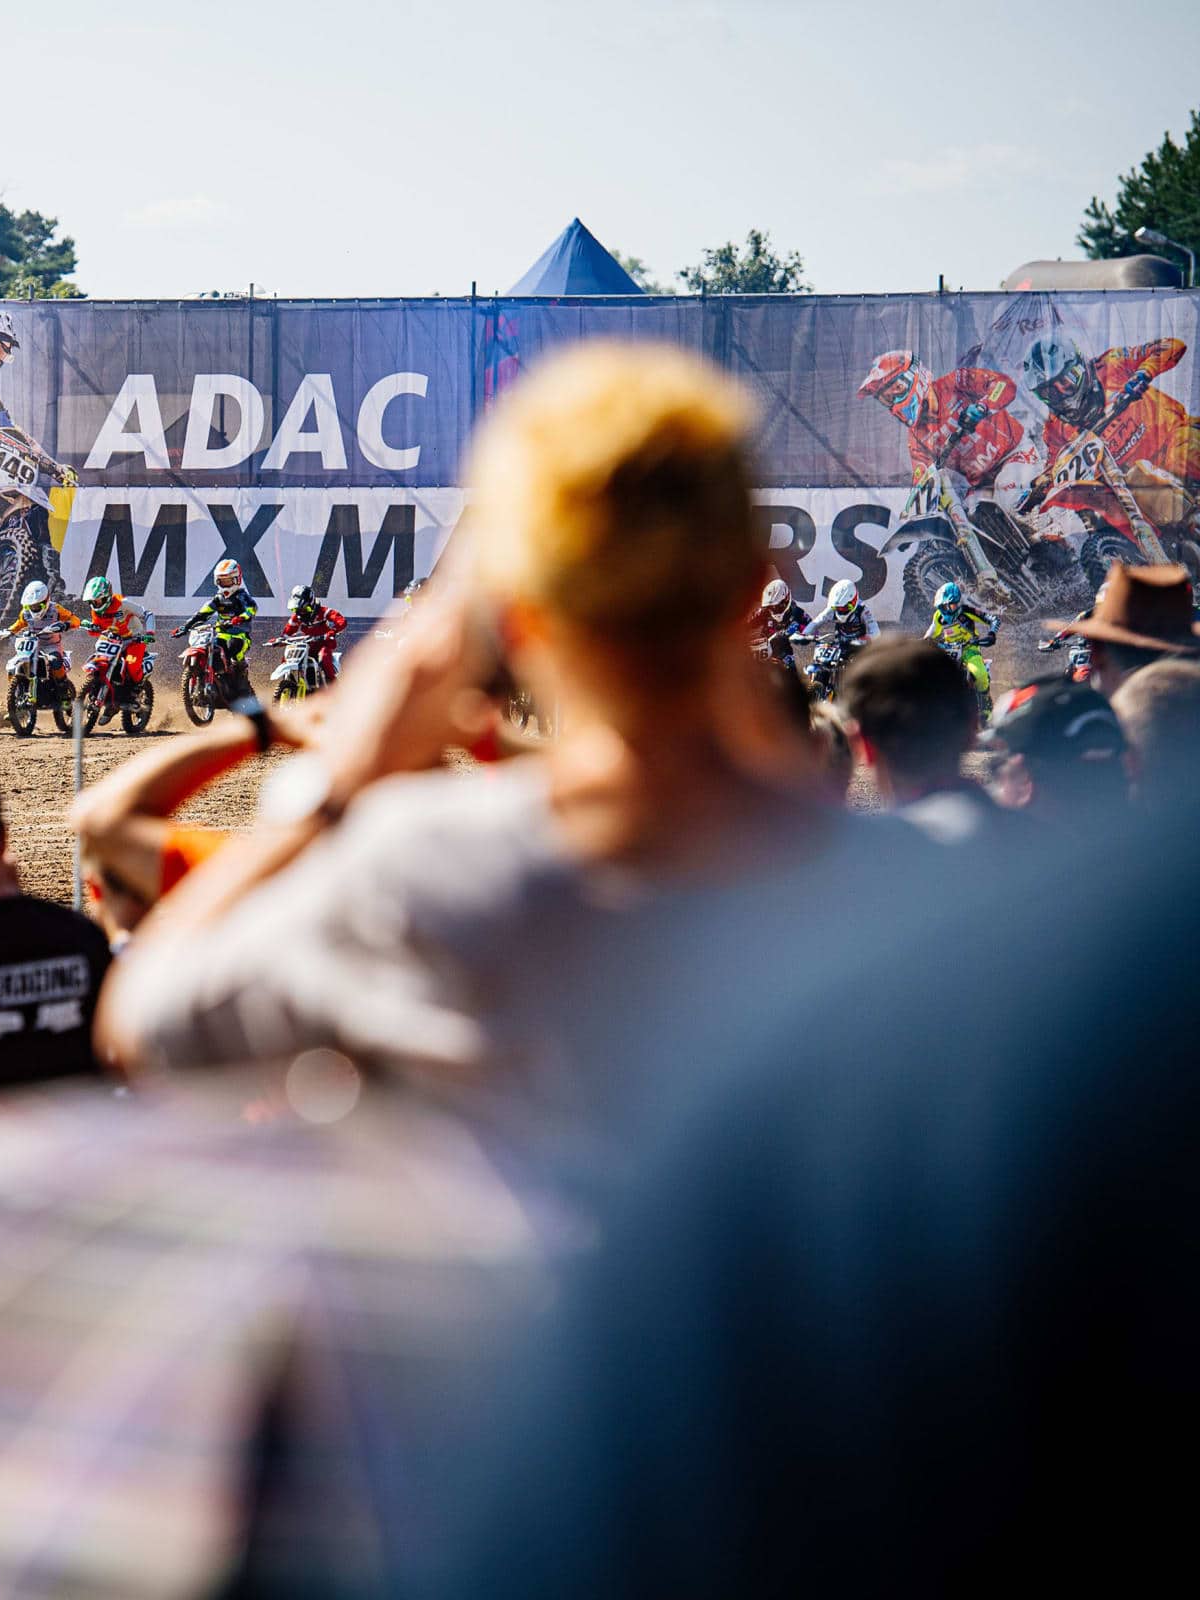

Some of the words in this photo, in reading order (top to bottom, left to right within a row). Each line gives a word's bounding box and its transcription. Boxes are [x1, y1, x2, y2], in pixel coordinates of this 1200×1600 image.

[82, 371, 430, 471] ADAC
[81, 503, 286, 599] MX
[98, 641, 121, 655] 20
